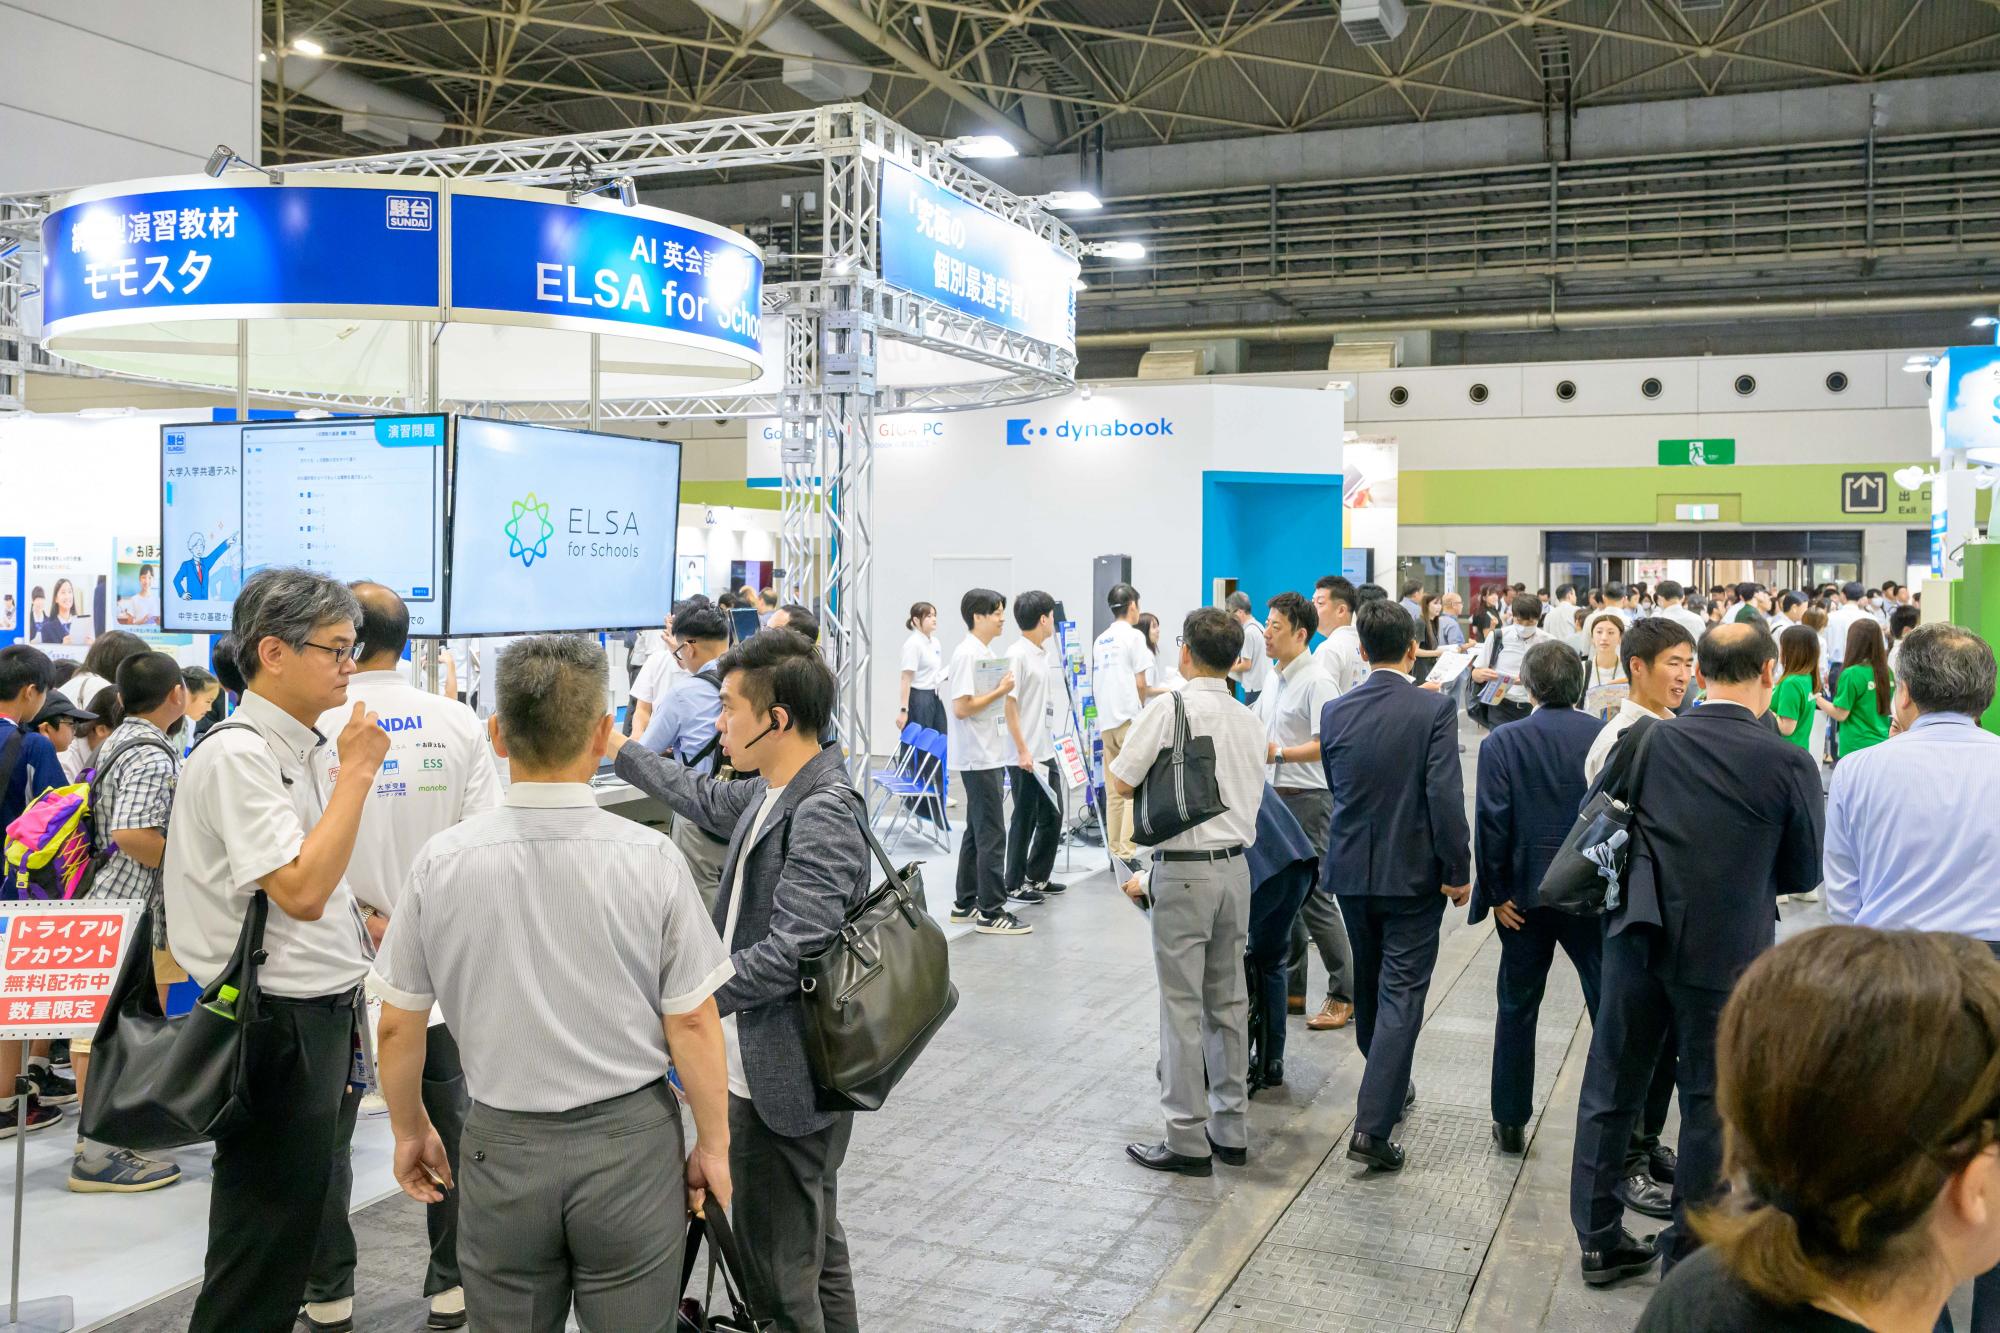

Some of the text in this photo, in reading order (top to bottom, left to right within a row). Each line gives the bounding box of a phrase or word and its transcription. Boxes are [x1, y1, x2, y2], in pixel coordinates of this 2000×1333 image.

[72, 206, 239, 254] 演習教材
[390, 217, 428, 228] SUNDAI
[629, 235, 657, 265] AI
[84, 249, 212, 300] モモスタ
[536, 262, 651, 313] ELSA
[661, 280, 709, 322] for
[388, 423, 436, 439] 演習問題
[923, 422, 944, 436] PC
[1055, 417, 1175, 441] dynabook
[1899, 490, 1932, 502] 出口
[1899, 506, 1917, 514] Exit
[568, 507, 640, 536] ELSA
[568, 541, 640, 558] for Schools
[377, 715, 423, 732] NDAI
[423, 758, 443, 769] ESS
[18, 920, 119, 939] トライアル
[10, 944, 113, 964] アカウント
[3, 972, 110, 992] 無料配布中
[8, 1000, 96, 1020] 数量限定
